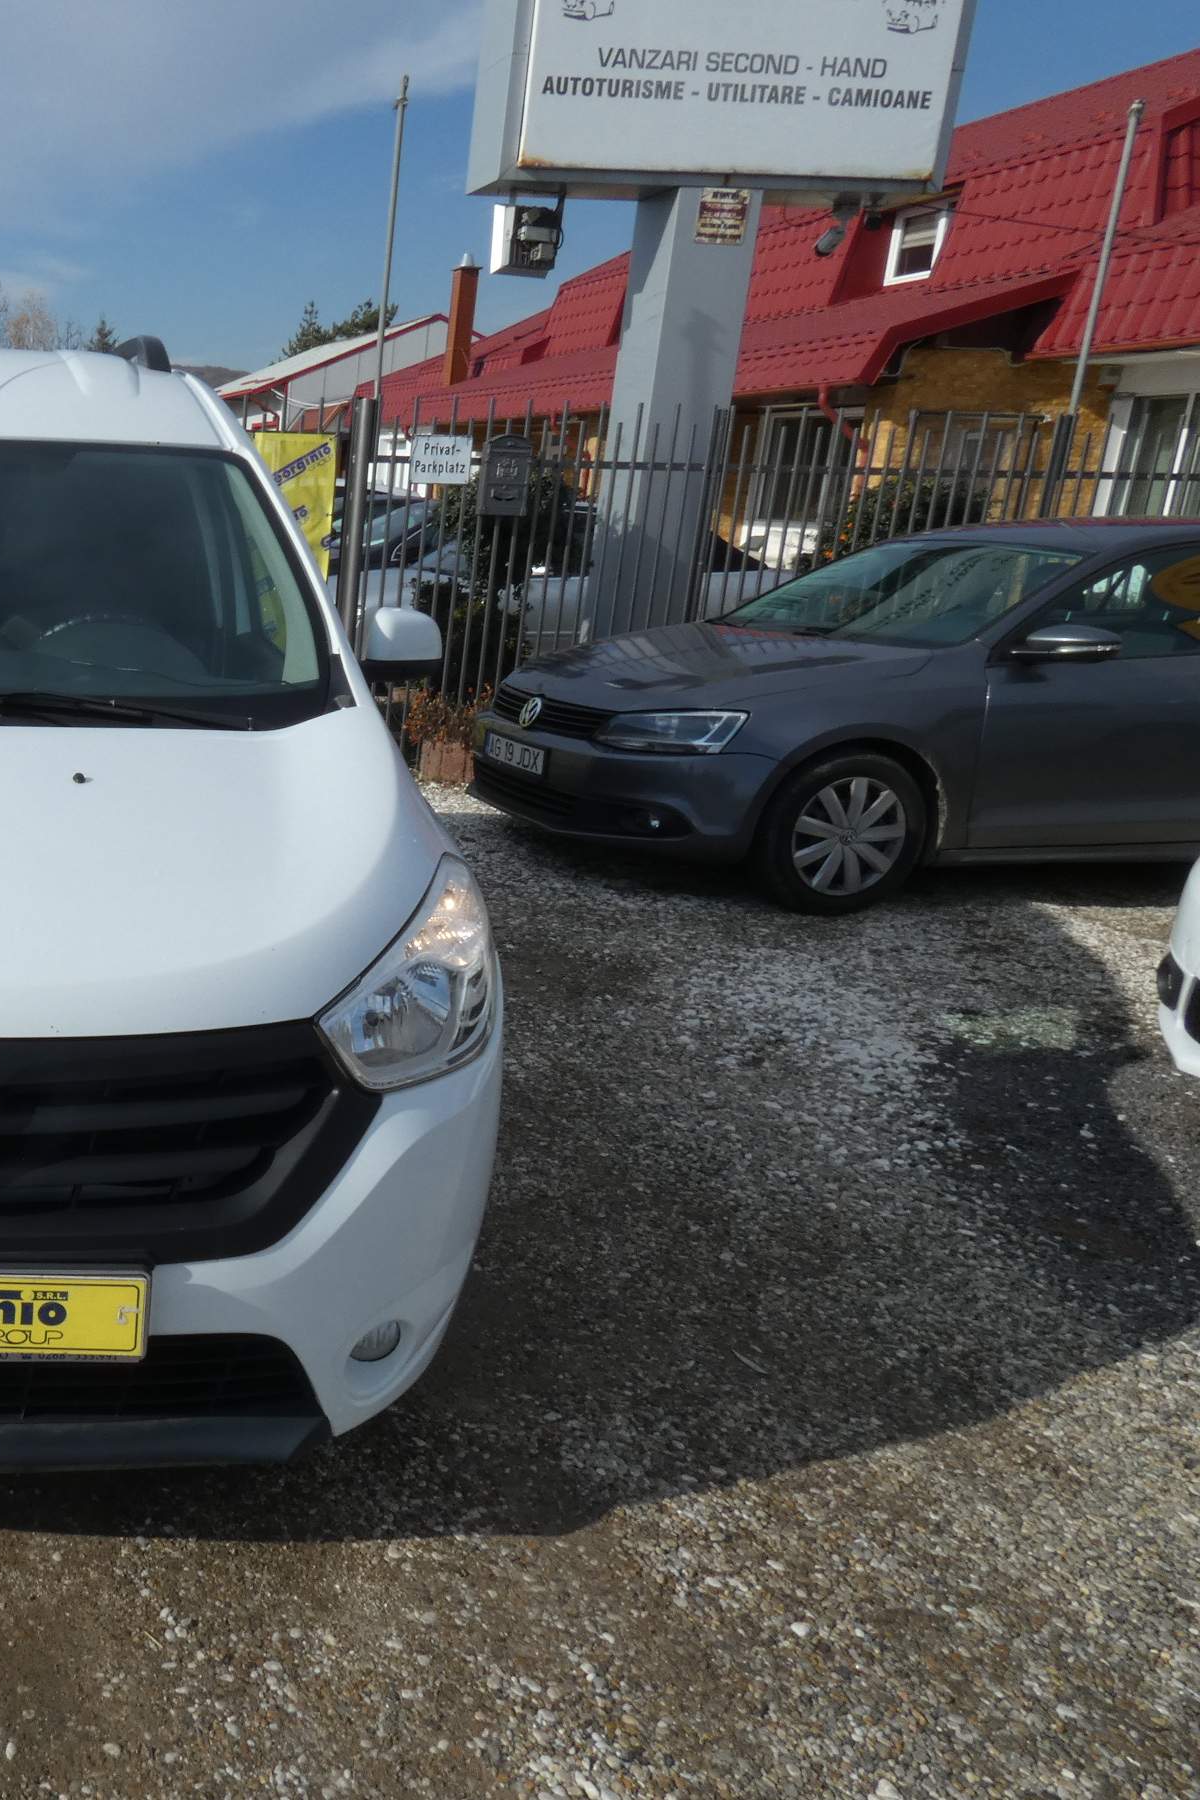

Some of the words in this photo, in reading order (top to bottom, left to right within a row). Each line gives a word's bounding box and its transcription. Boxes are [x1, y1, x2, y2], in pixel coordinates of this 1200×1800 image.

[598, 47, 698, 72] VANZARI
[705, 51, 801, 75] SECOND
[820, 55, 887, 79] HAND
[542, 76, 685, 101] AUTOTURISME
[706, 81, 807, 105] UTILITARE
[827, 87, 933, 110] CAMIOANE
[424, 443, 462, 456] Privat-
[414, 460, 466, 477] Parkplatz
[488, 735, 501, 758] AG
[505, 740, 514, 761] 19
[516, 747, 541, 772] JDX
[35, 1291, 67, 1301] S.R.L.
